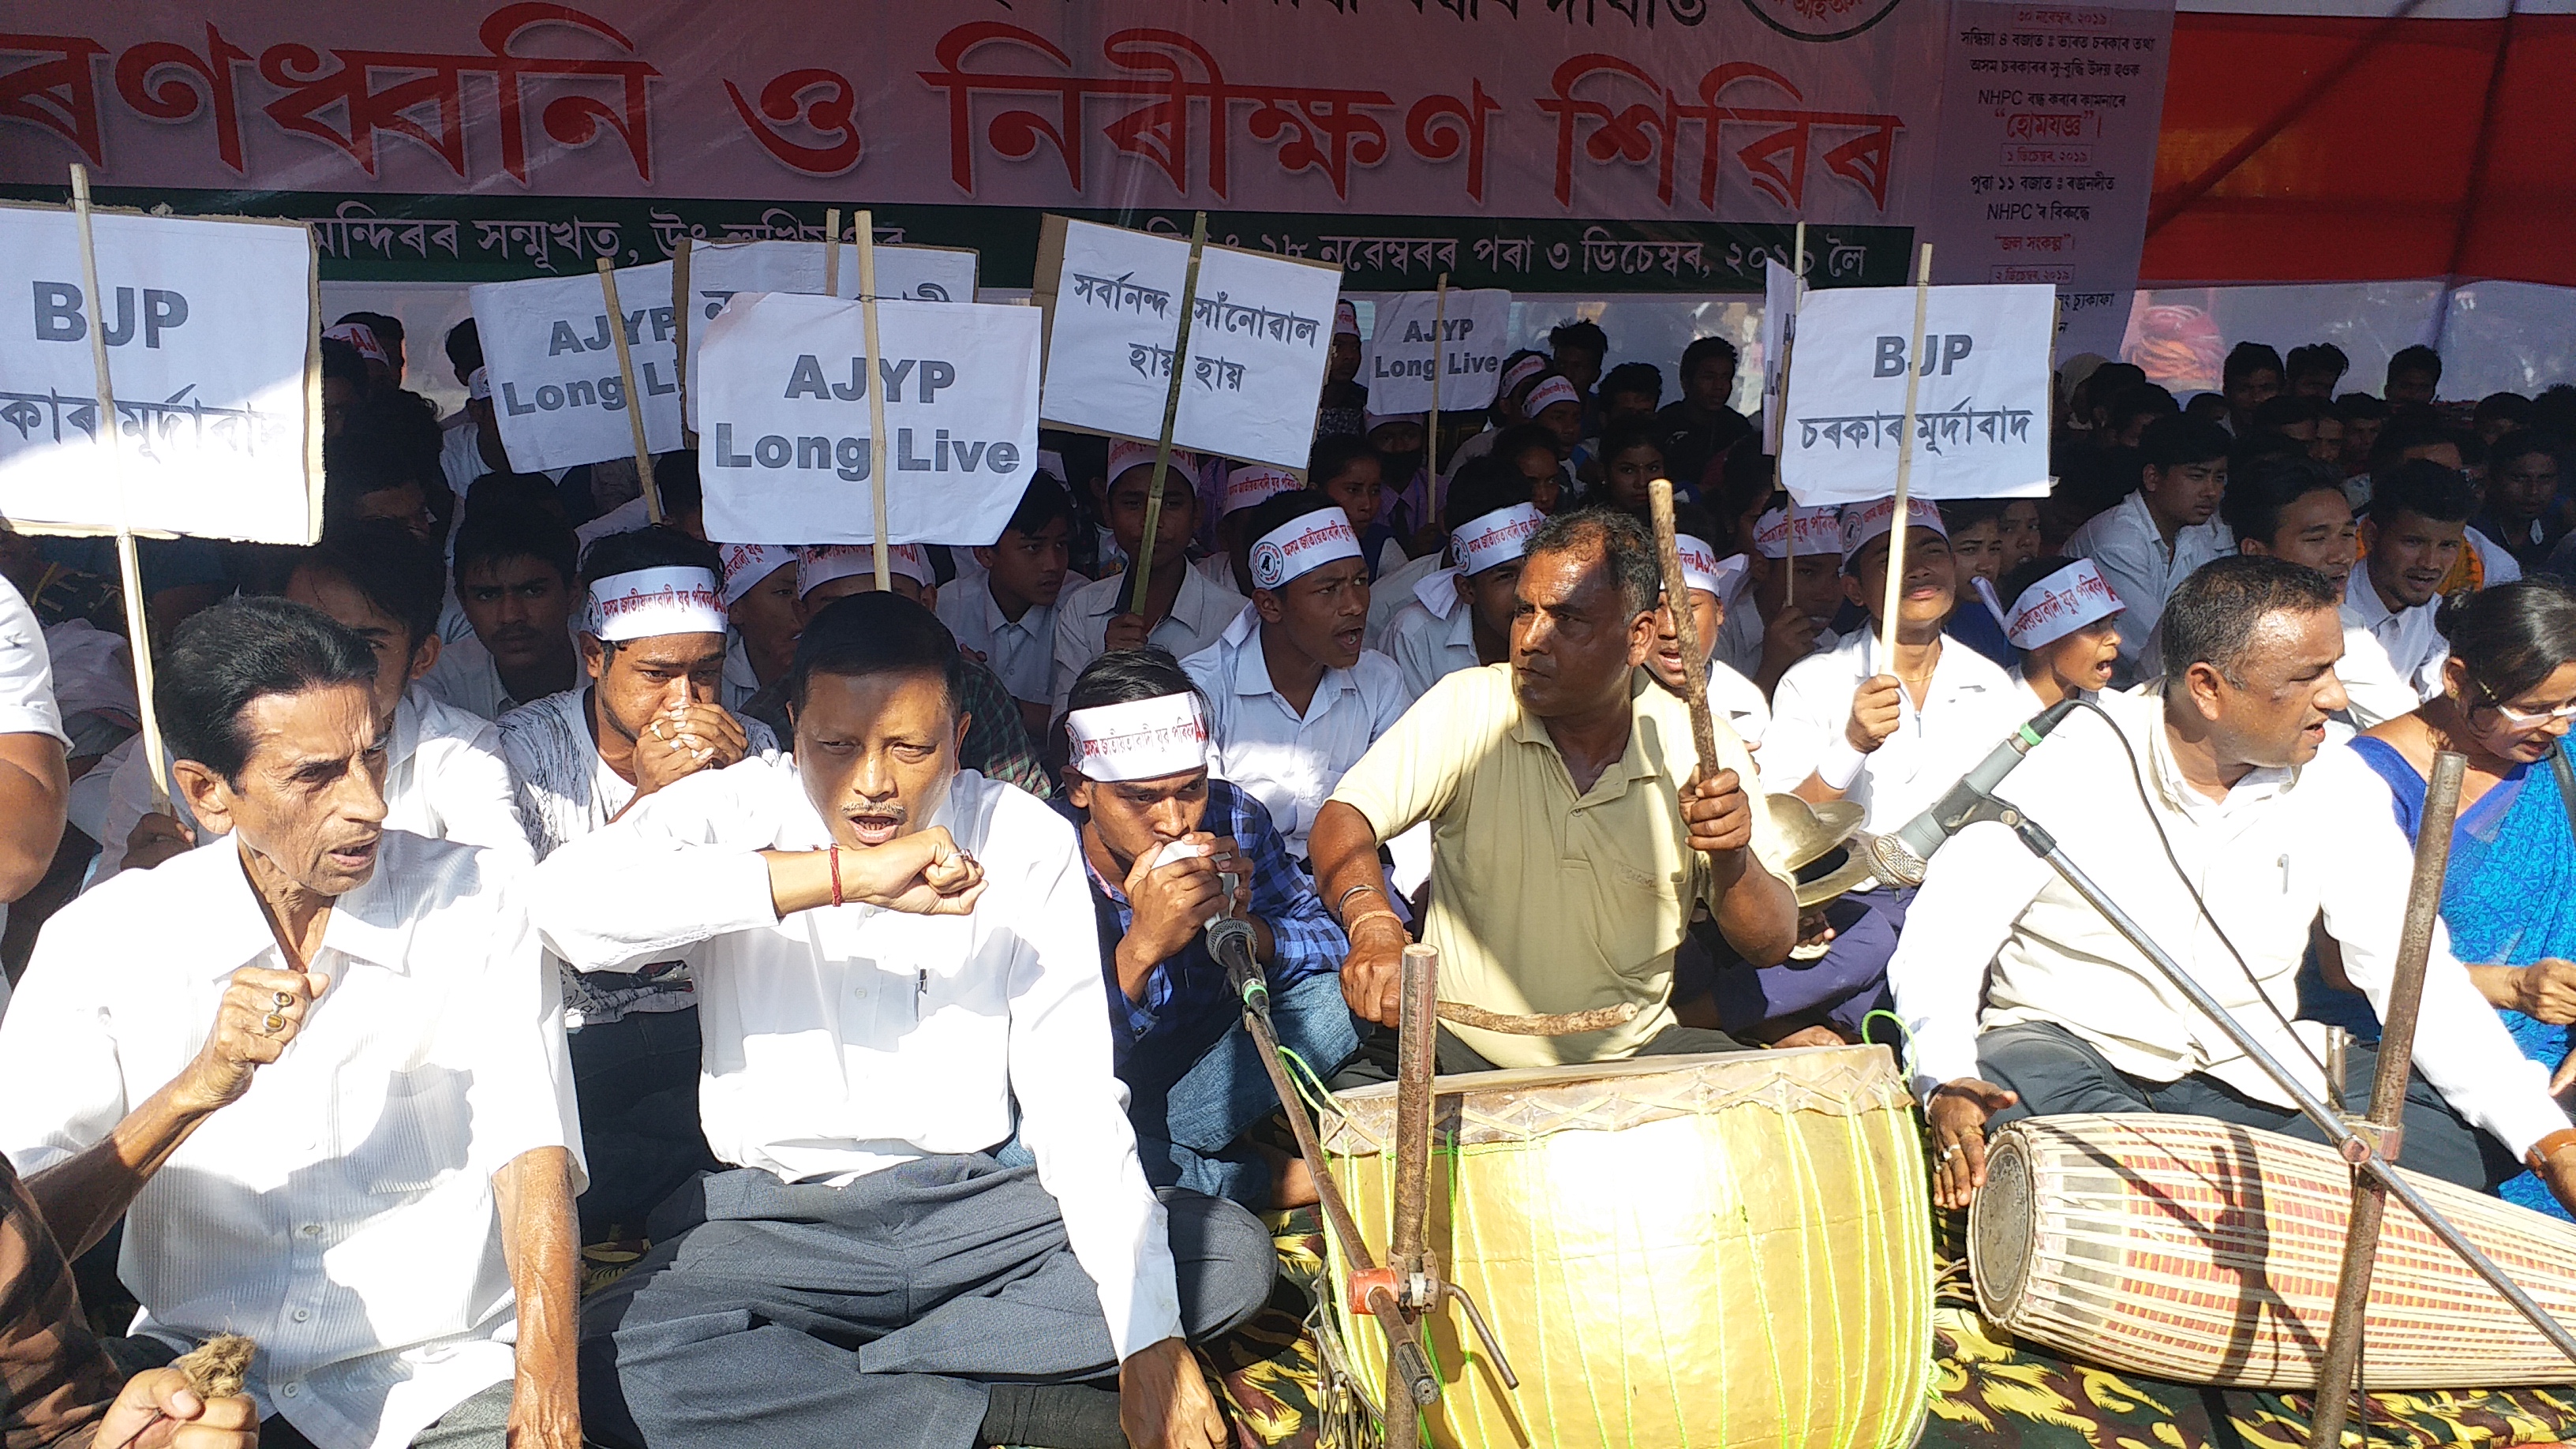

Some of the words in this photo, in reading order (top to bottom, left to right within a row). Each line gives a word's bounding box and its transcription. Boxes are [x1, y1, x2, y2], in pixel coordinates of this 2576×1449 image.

[722, 68, 867, 178] ও
[915, 21, 1501, 205] নিৰীক্ষণ
[1978, 89, 2023, 105] NHPC
[1473, 234, 1534, 273] পৰা
[1546, 244, 1570, 271] ৩
[32, 280, 189, 350] BJP
[549, 306, 677, 357] AJYP
[1402, 318, 1473, 343] AJYP
[1194, 355, 1247, 392] হায়
[1375, 356, 1436, 381] Long
[1447, 352, 1499, 376] Live
[1873, 335, 1973, 378] BJP
[501, 375, 629, 417] Long
[784, 354, 956, 404] AJYP
[1797, 410, 1906, 451] চৰকাৰ
[716, 422, 872, 482] Long
[897, 428, 1020, 474] Live
